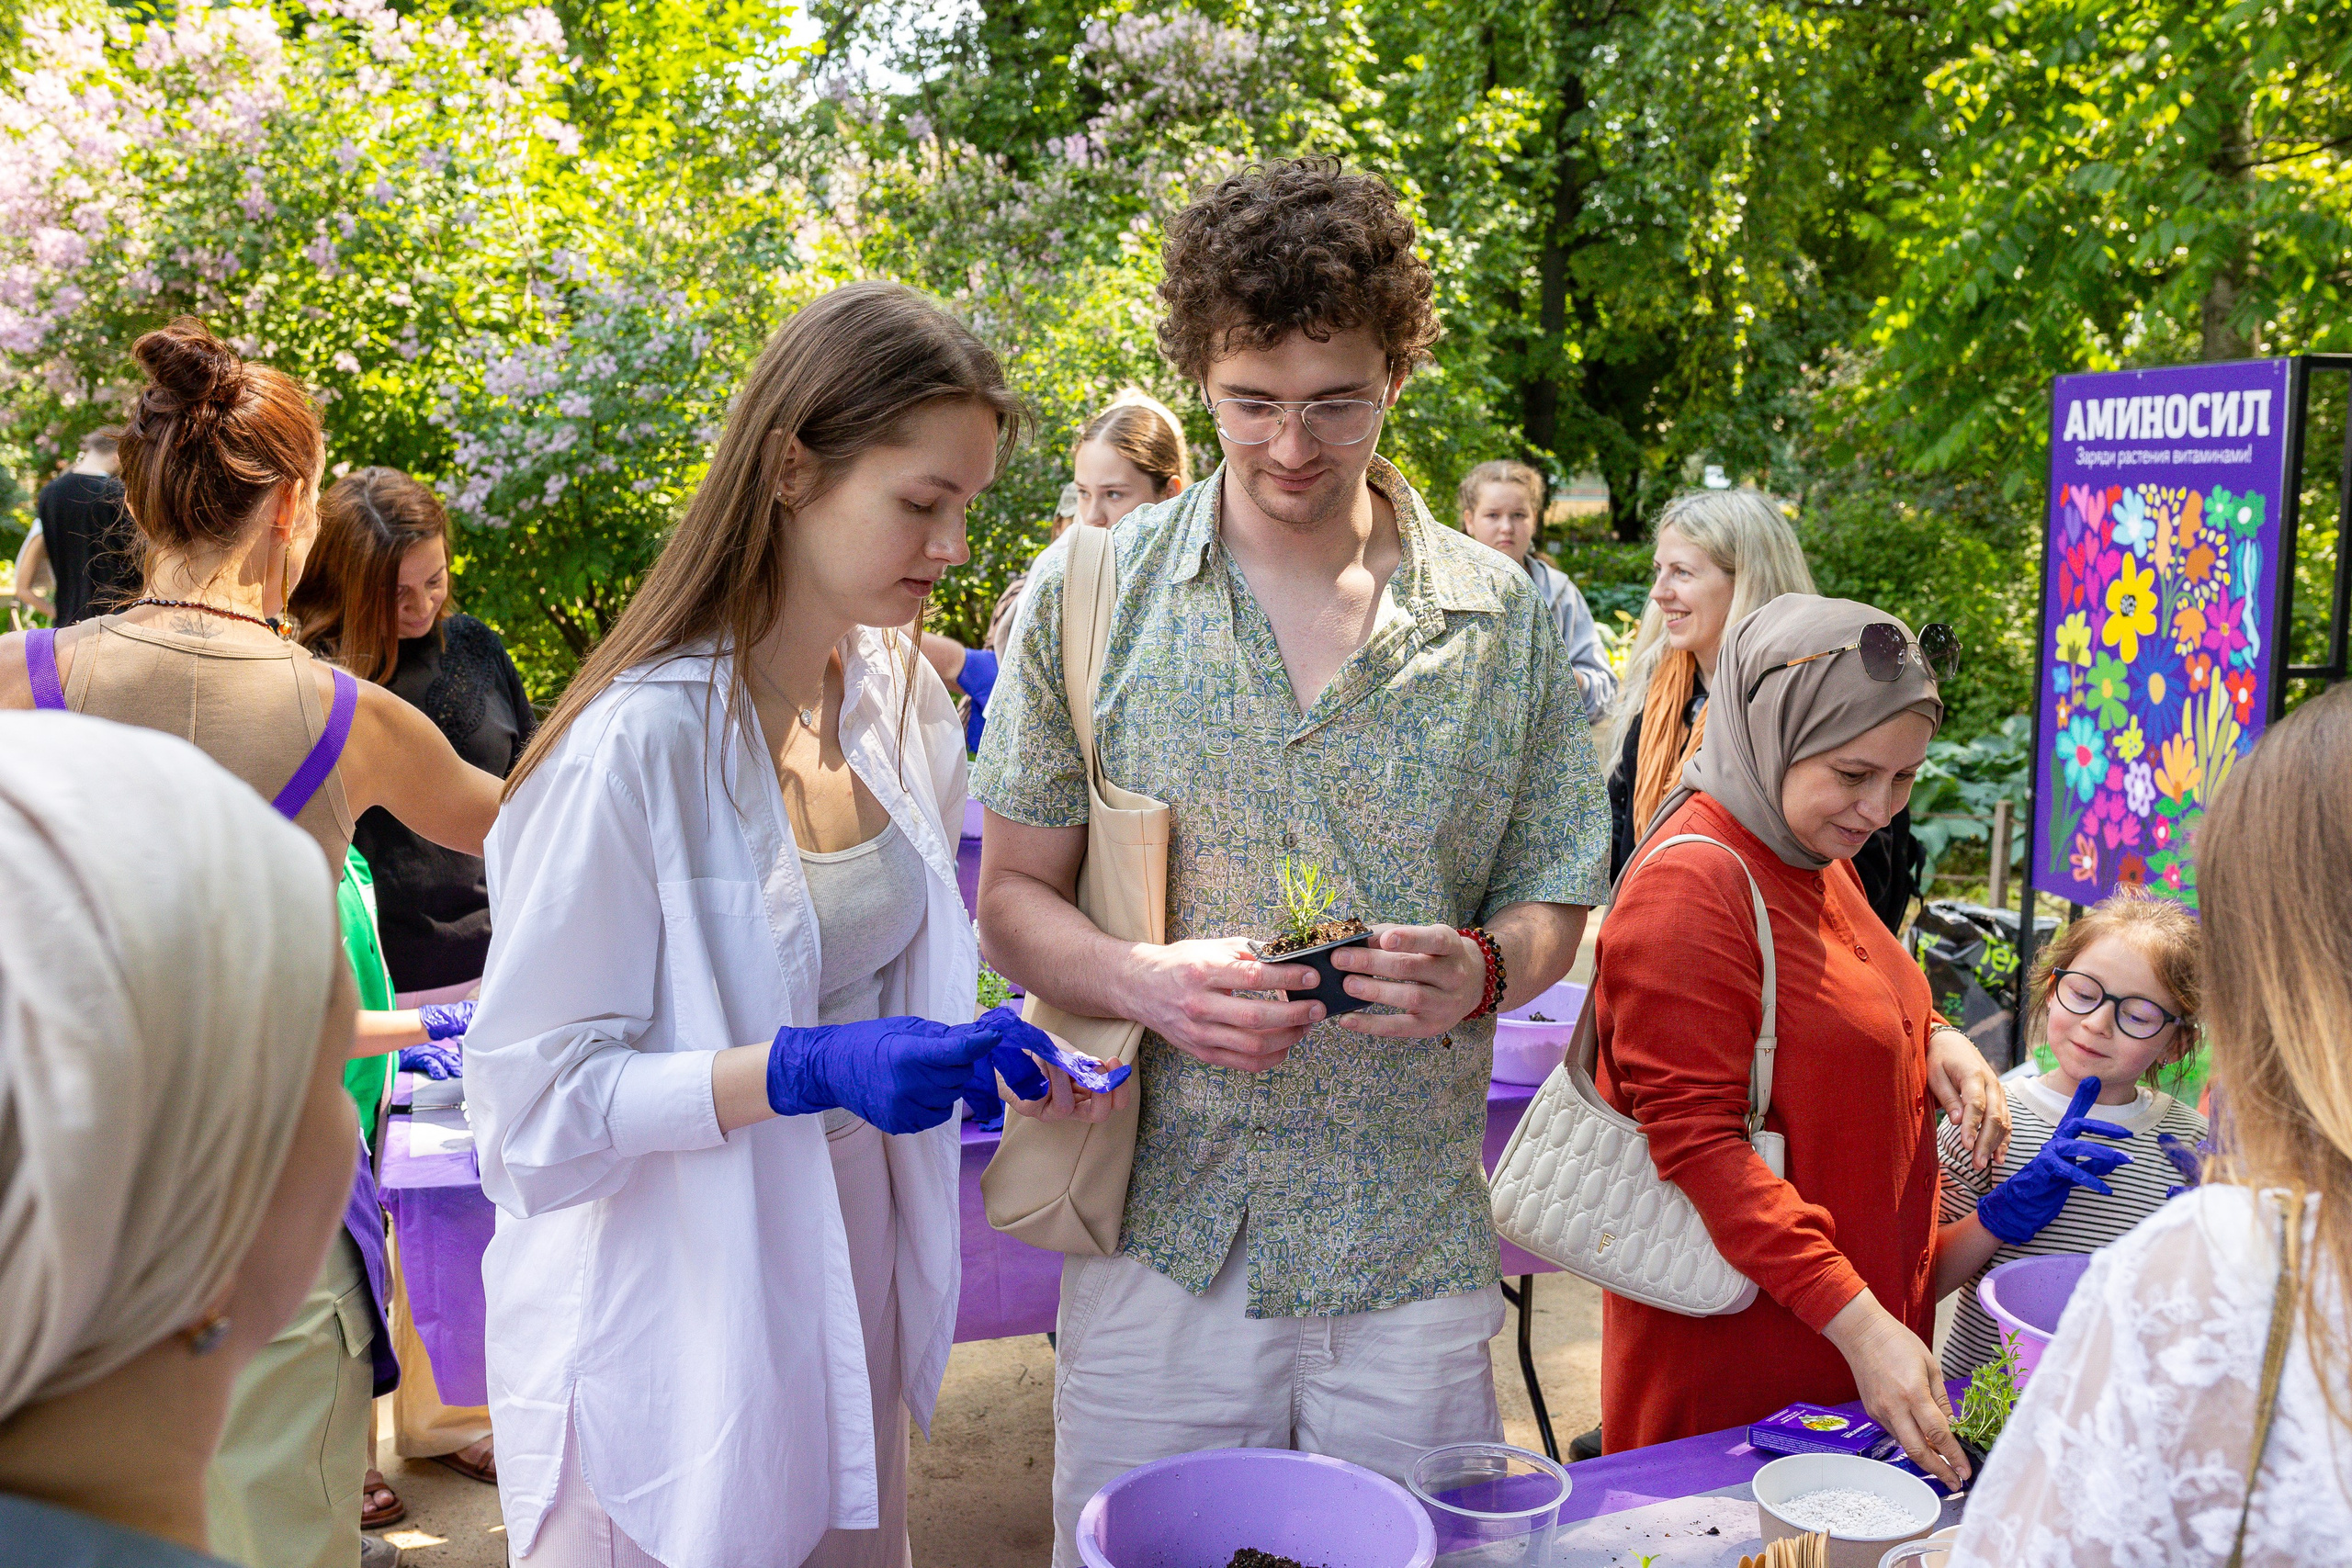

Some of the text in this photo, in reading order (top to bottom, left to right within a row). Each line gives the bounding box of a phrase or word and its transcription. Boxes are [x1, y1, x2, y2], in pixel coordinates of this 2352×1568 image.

[2063, 389, 2272, 442] АМИНОСИЛ
[2075, 443, 2253, 470] Заряди растения витаминами!
[1598, 1232, 1617, 1254] F
